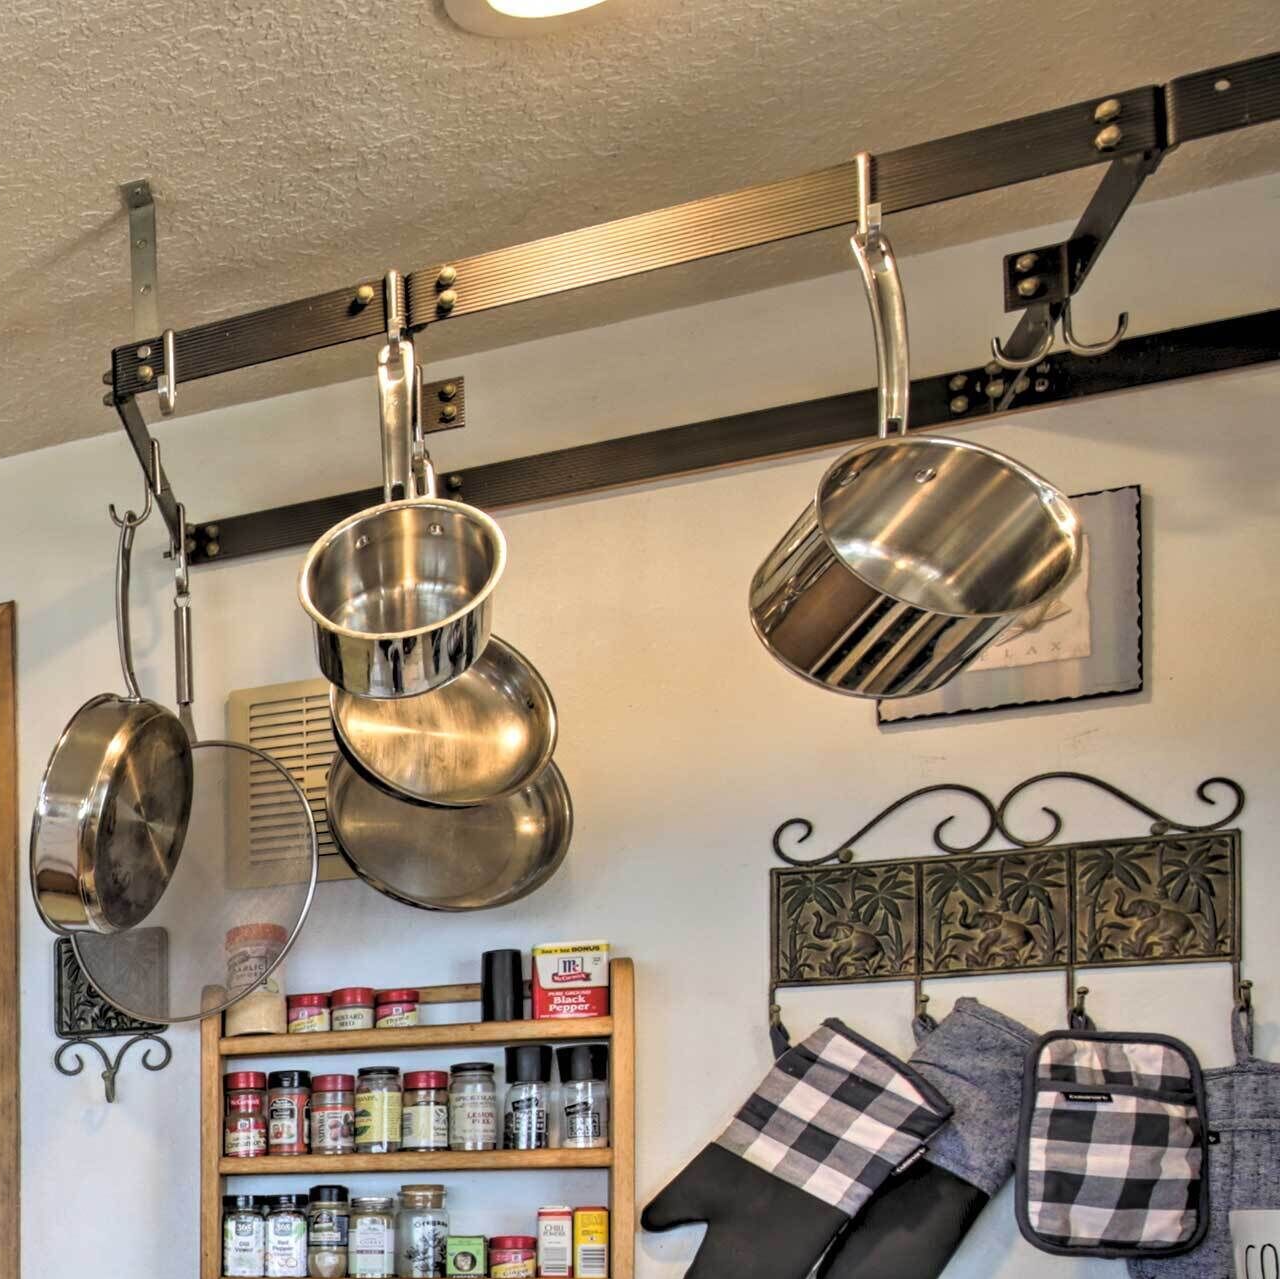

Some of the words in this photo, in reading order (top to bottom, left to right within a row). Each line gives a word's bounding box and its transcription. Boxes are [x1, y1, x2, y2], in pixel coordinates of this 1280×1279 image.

[571, 945, 600, 953] BONUS
[553, 995, 586, 1004] Black
[548, 1003, 590, 1014] Pepper
